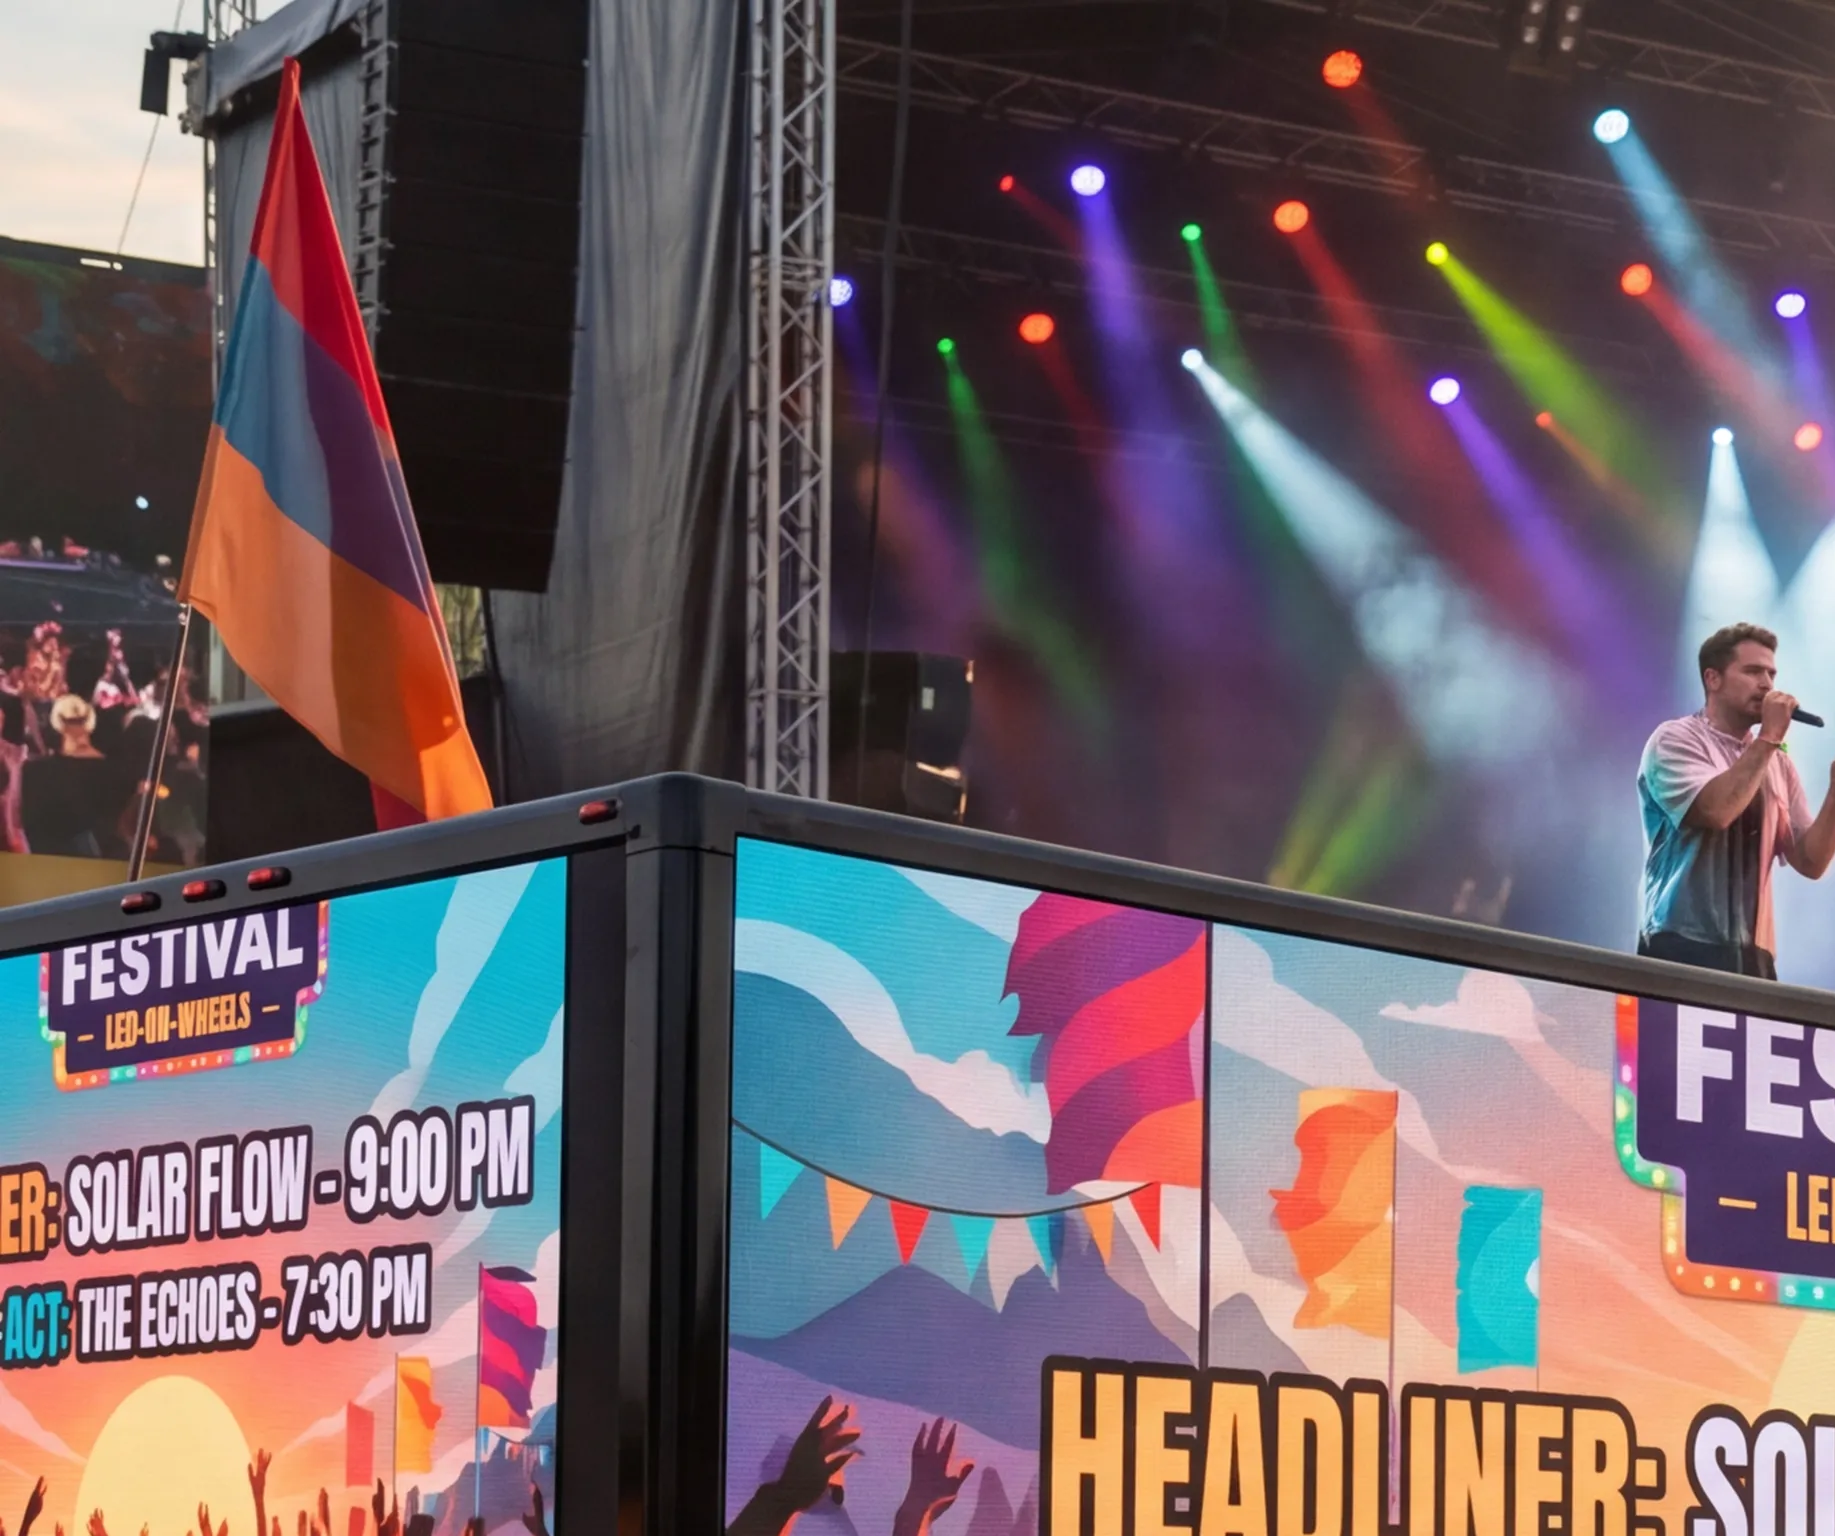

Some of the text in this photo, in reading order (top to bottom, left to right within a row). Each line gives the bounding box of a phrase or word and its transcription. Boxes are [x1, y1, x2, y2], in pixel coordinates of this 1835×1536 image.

[62, 907, 304, 1006] FESTIVAL
[68, 1151, 187, 1248] SOLAR
[199, 1134, 310, 1233] FLOW
[349, 1117, 447, 1215] 9:00
[461, 1104, 531, 1200] PM
[78, 1283, 132, 1355] THE
[140, 1271, 257, 1347] ECHOES
[285, 1255, 362, 1336] 7:30
[372, 1253, 428, 1327] PM
